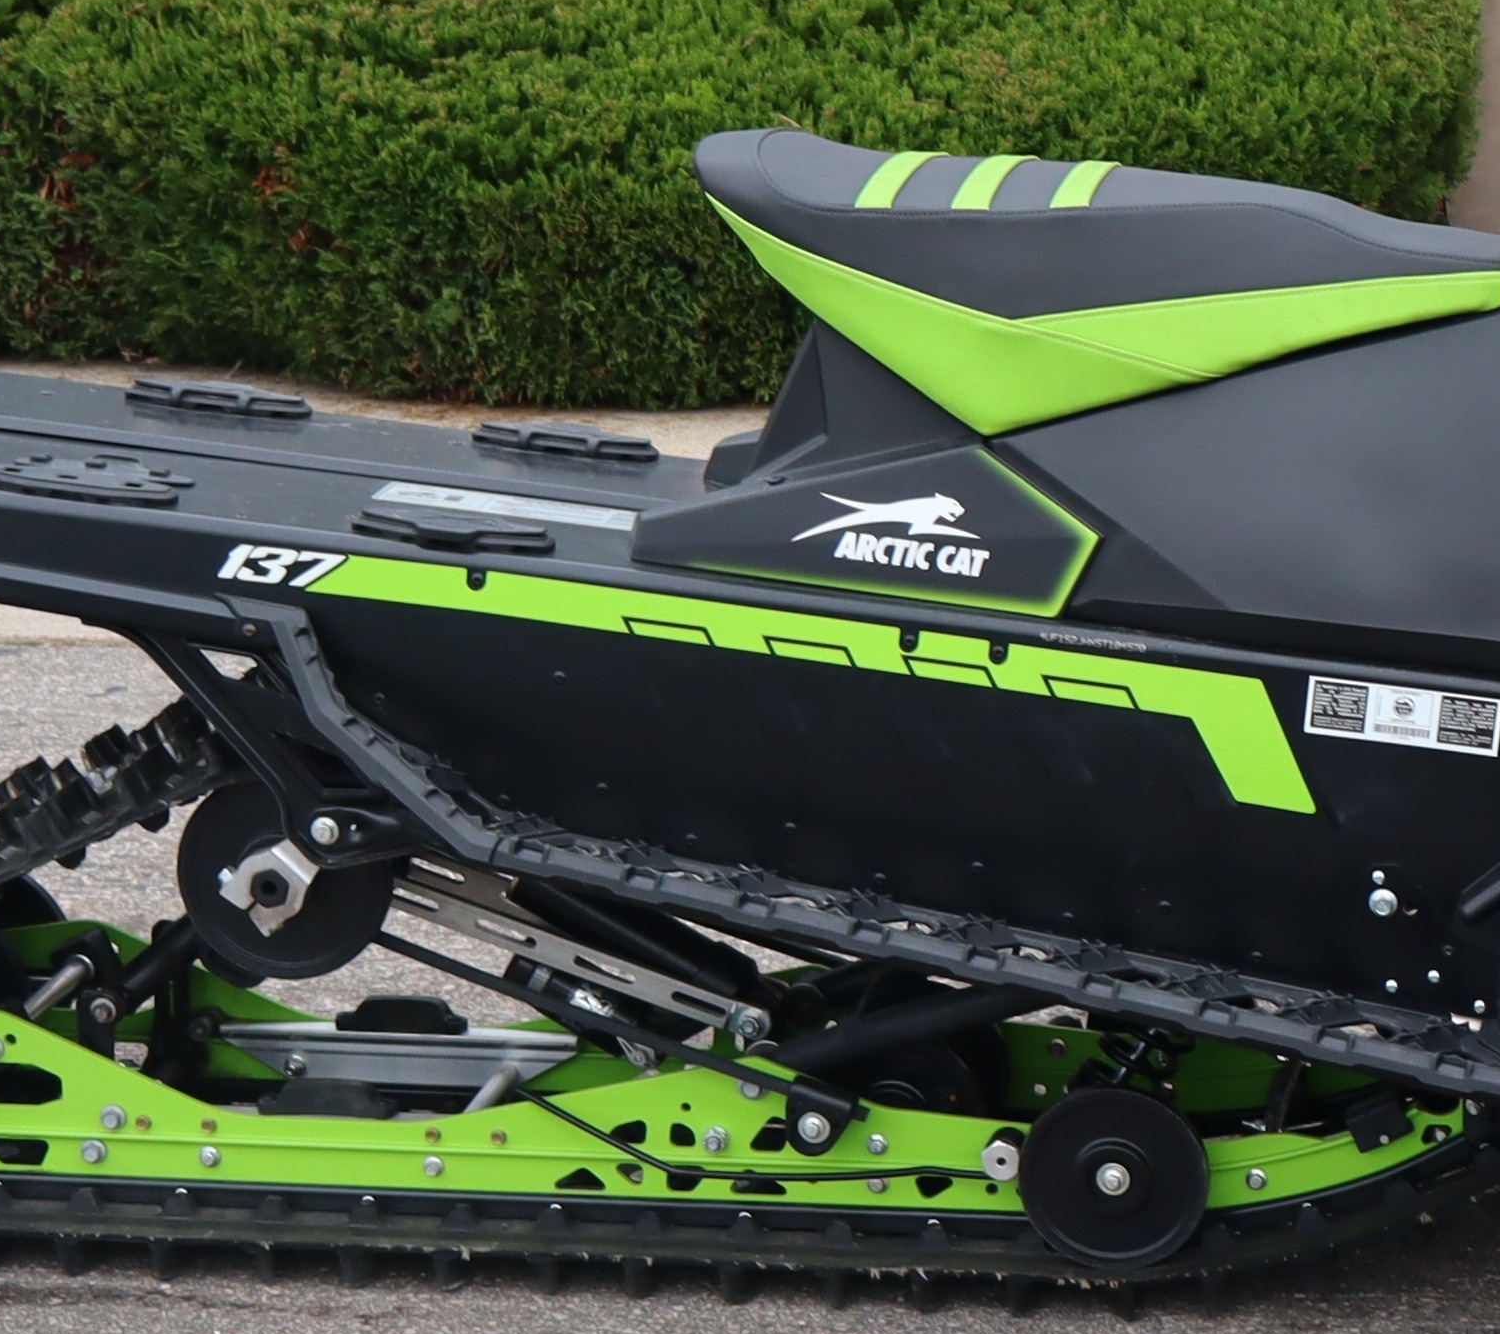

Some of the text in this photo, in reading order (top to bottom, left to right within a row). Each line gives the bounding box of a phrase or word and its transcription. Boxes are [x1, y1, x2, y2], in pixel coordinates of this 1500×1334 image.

[216, 543, 348, 588] 137
[834, 531, 991, 578] ARCTIC CAT
